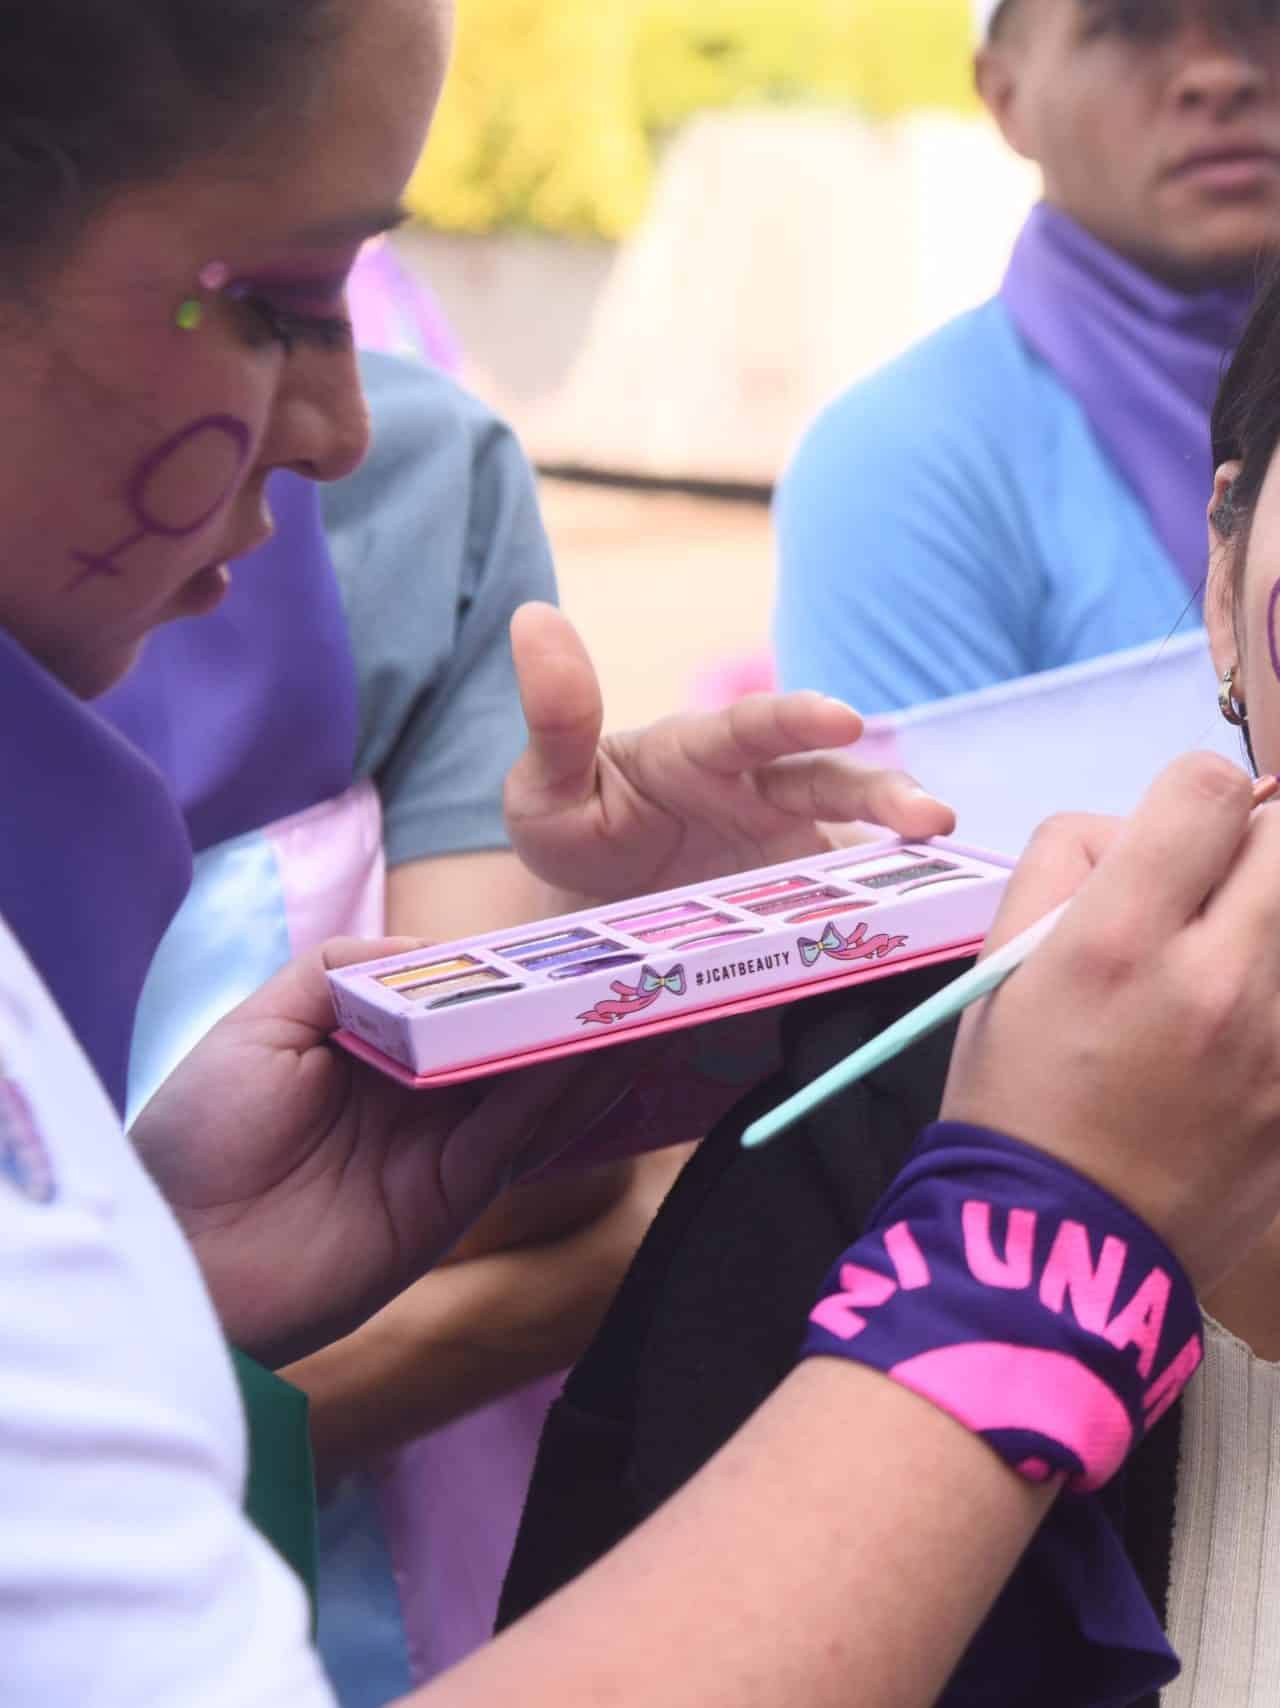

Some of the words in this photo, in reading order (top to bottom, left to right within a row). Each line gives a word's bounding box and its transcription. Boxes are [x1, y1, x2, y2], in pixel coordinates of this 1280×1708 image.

[696, 951, 790, 985] #JCATBEAUTY
[809, 1220, 931, 1340] NI
[961, 1200, 1172, 1379] UNA
